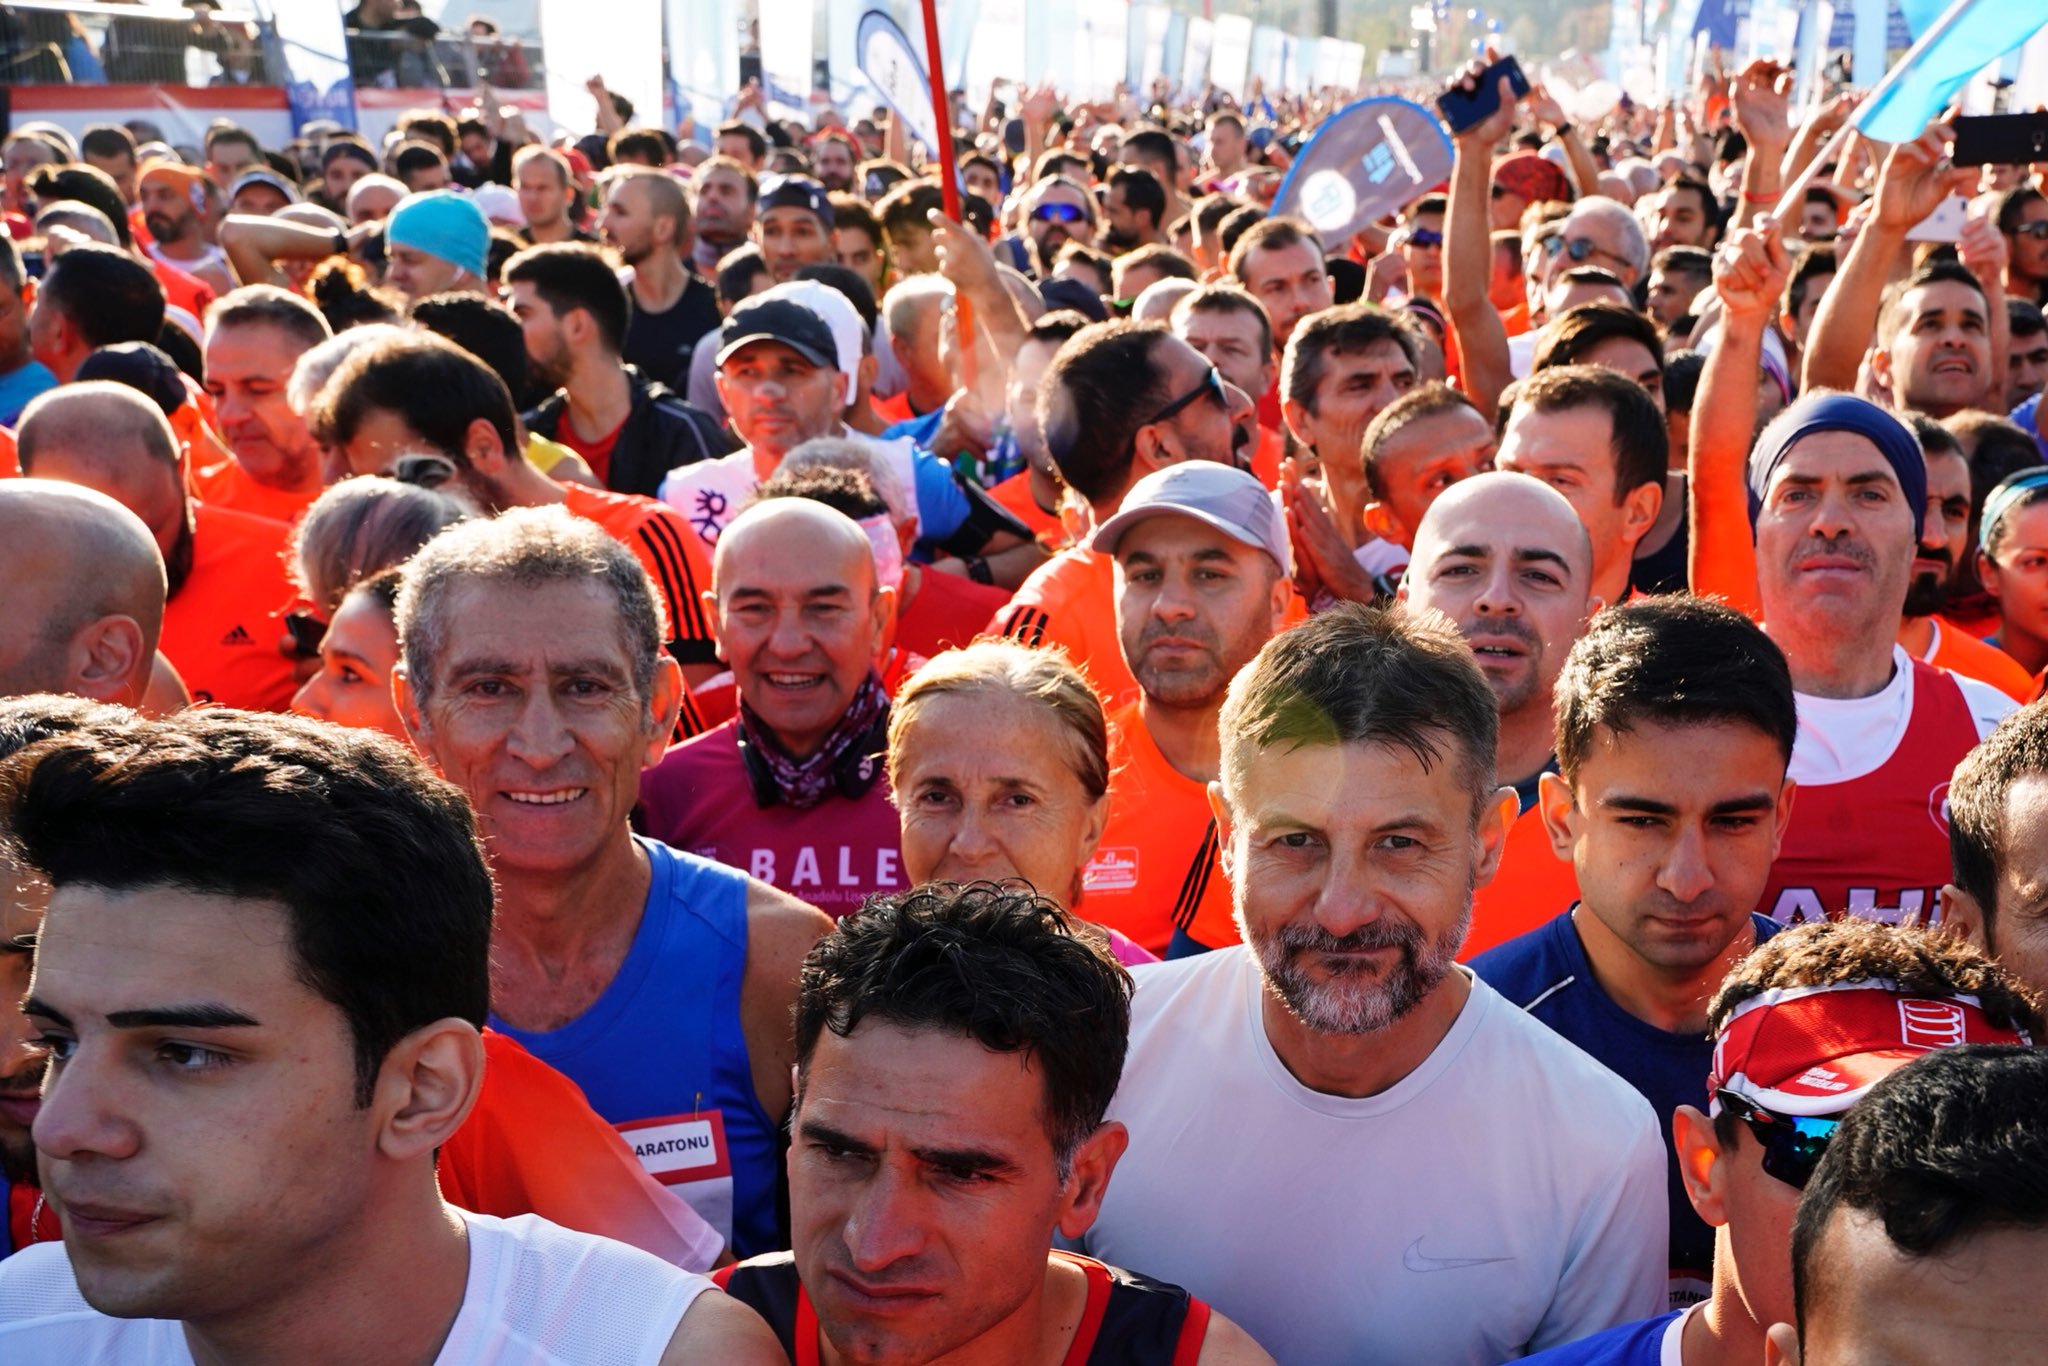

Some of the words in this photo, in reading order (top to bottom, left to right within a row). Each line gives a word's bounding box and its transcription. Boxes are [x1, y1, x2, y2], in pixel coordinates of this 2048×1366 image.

[750, 846, 899, 887] BALE
[1770, 887, 1942, 926] AH
[635, 1135, 709, 1156] ARATONU
